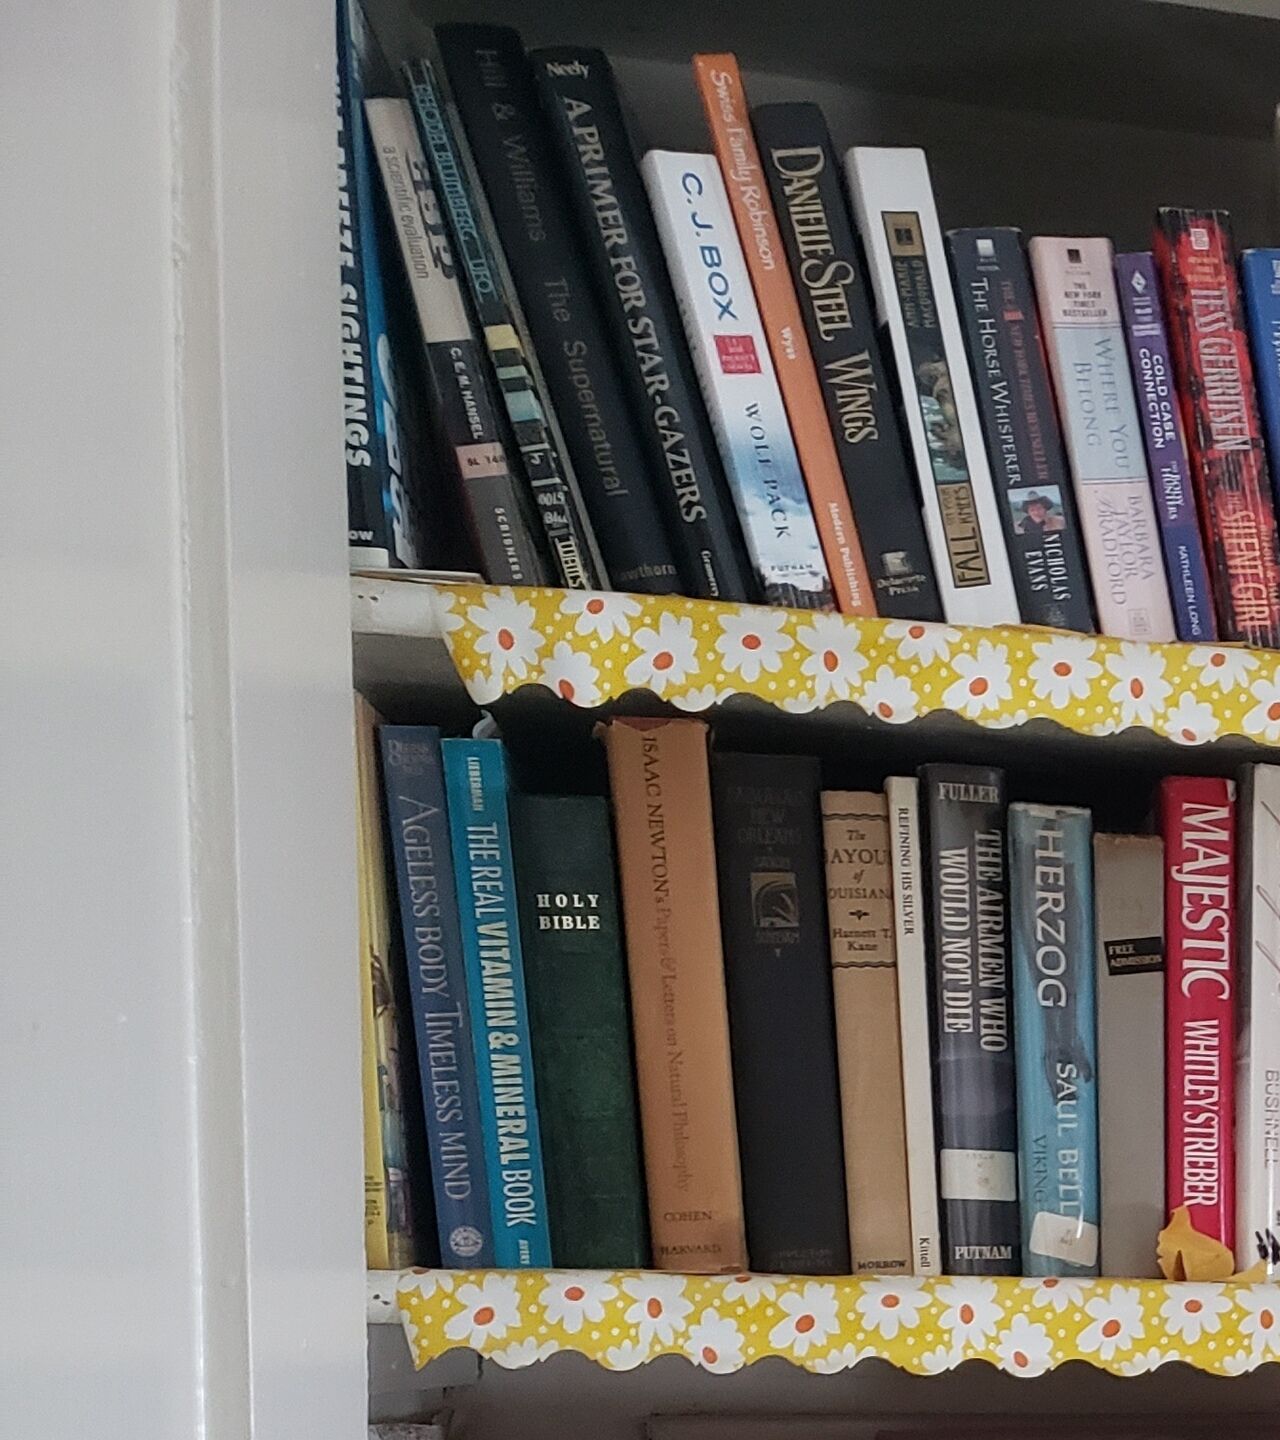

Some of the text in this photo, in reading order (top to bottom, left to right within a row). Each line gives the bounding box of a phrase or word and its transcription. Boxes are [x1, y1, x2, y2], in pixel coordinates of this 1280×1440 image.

[711, 68, 775, 271] Swiss Family Robinson
[564, 98, 707, 523] A PRIMER FOR STAR-GAZERS
[971, 277, 1022, 485] THE HORSE WHISPERER
[1138, 347, 1176, 449] COLD CASE CONNECTION
[745, 402, 791, 539] WOLF PACK
[950, 526, 985, 585] FALL
[1025, 531, 1072, 602] NICHOLAS EVANS
[938, 782, 1000, 804] FULLER
[398, 795, 441, 919] AGELESS
[536, 893, 601, 930] HOLY BIBLE
[898, 807, 915, 936] REFINING HIS SILVER
[1034, 828, 1068, 1008] HERZOG
[1170, 801, 1230, 1001] MAJESTIC
[415, 926, 450, 1000] BODY
[939, 847, 974, 1033] WOULD NOT DIE
[974, 829, 1008, 1053] THE AIRMEN WHO
[424, 1001, 464, 1124] TIMELESS
[466, 821, 537, 1228] THE REAL VITAMIN & MINERAL BOOK
[1055, 1062, 1079, 1137] SAUL
[1183, 1019, 1220, 1207] WHITLEY STRIEBER
[438, 1131, 472, 1201] MIND
[664, 1211, 713, 1222] COHEN
[954, 1246, 1013, 1261] PUTNAM
